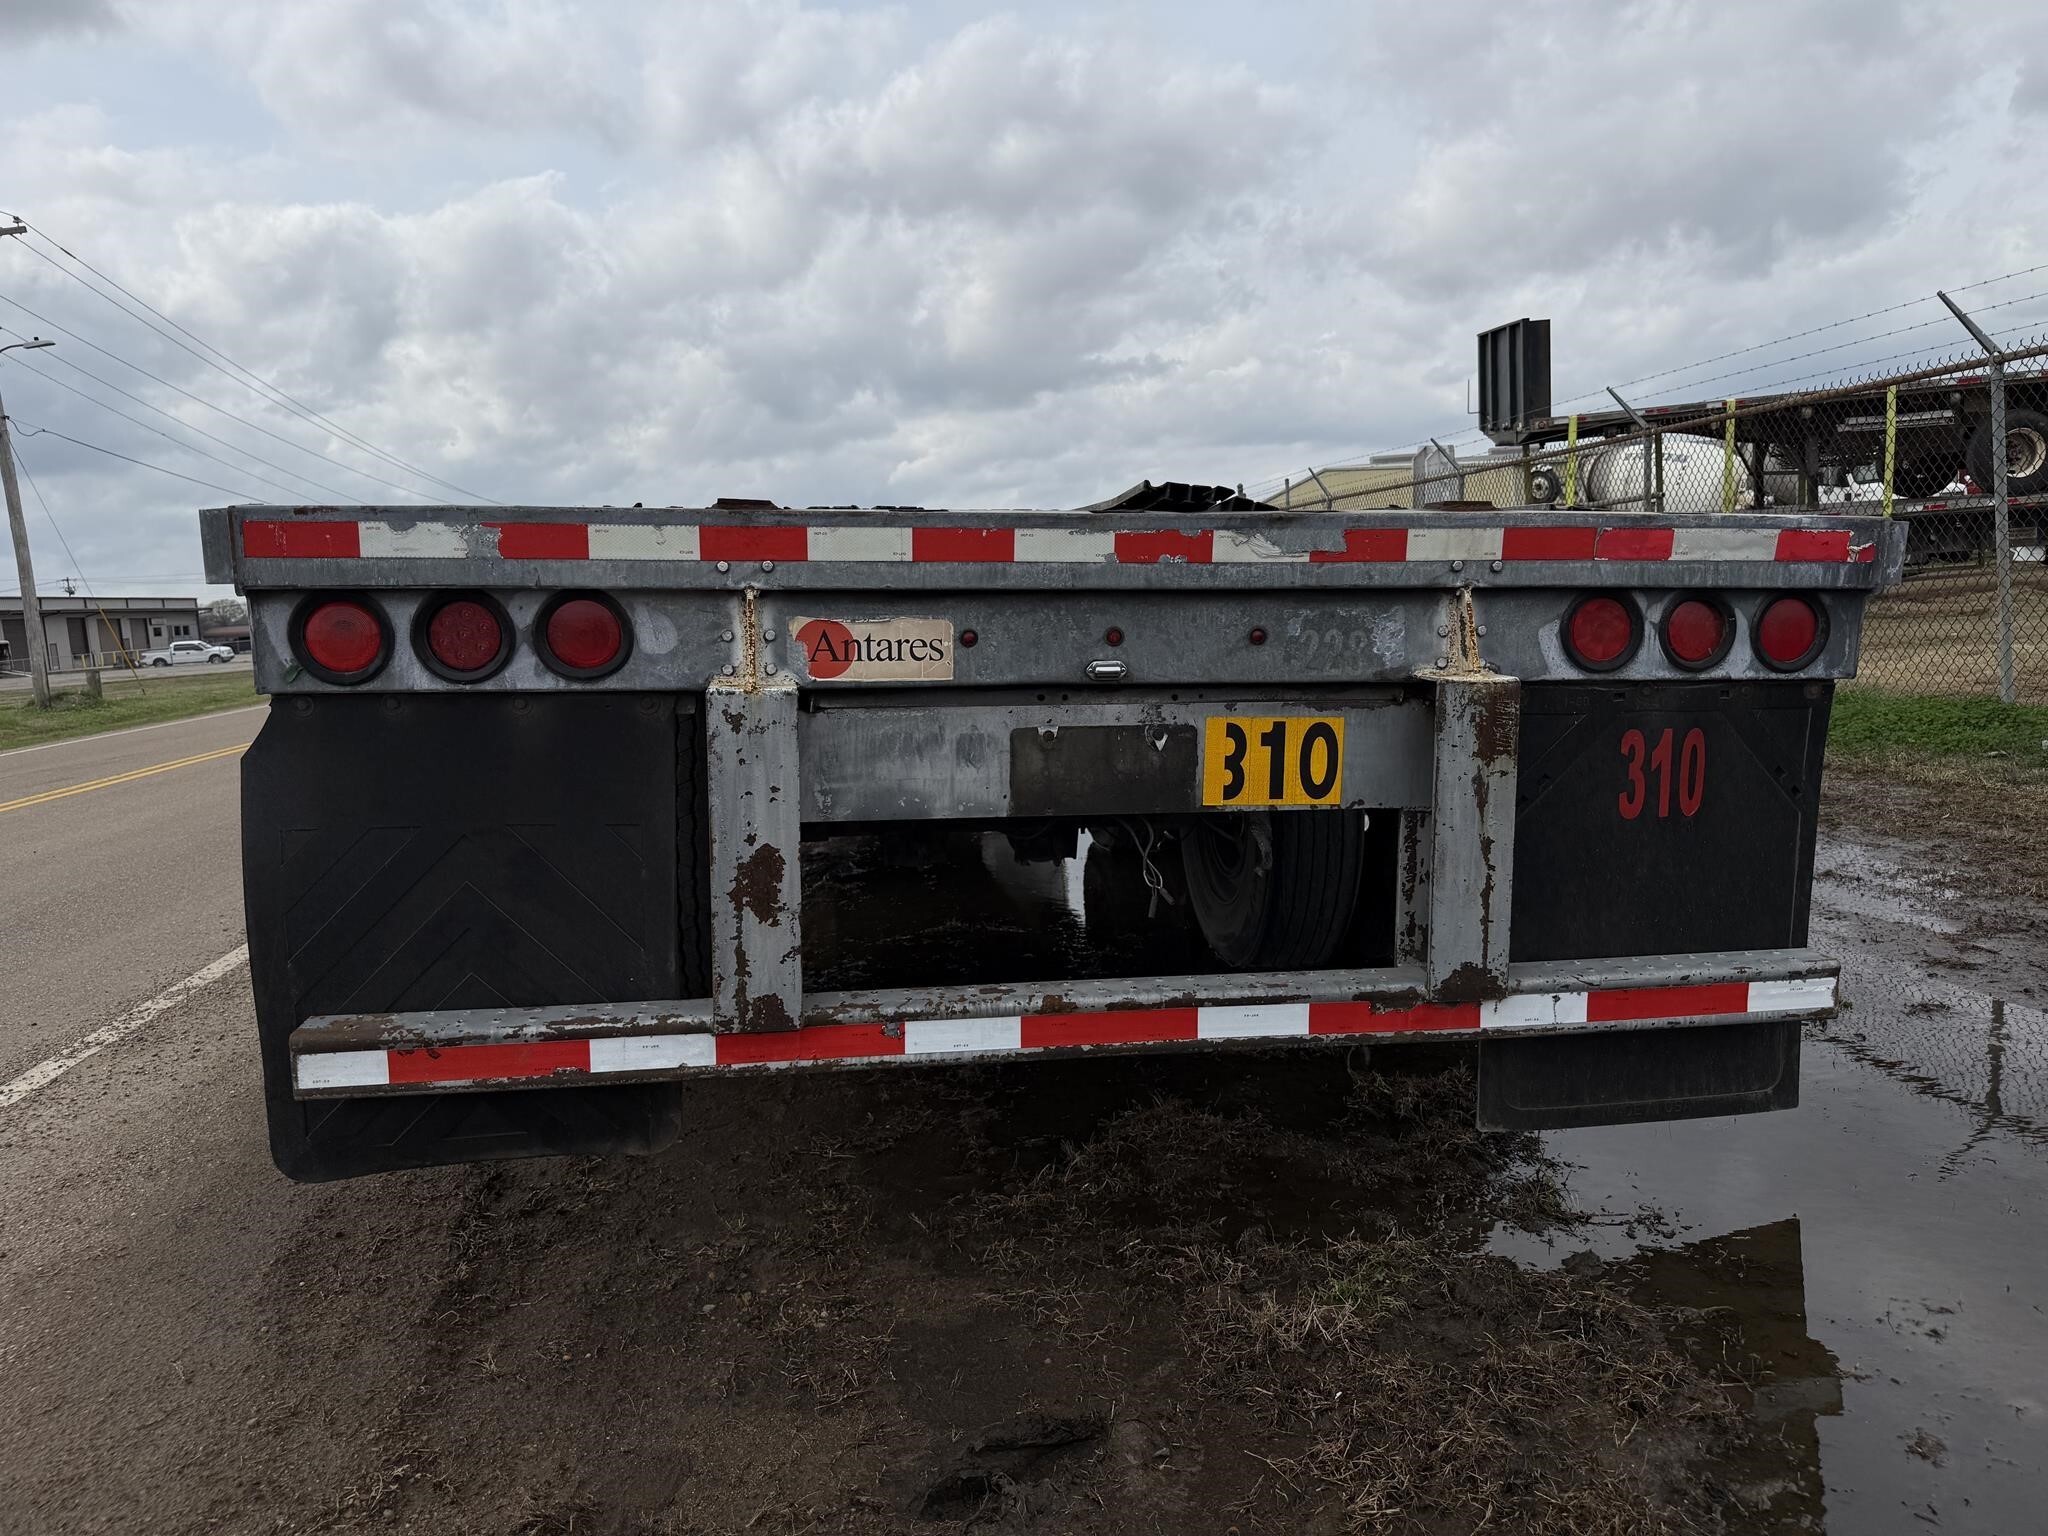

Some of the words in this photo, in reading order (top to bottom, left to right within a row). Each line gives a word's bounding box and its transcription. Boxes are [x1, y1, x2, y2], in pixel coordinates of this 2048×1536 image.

[808, 629, 944, 663] Antares
[1223, 721, 1339, 801] 310
[1618, 727, 1706, 819] 310
